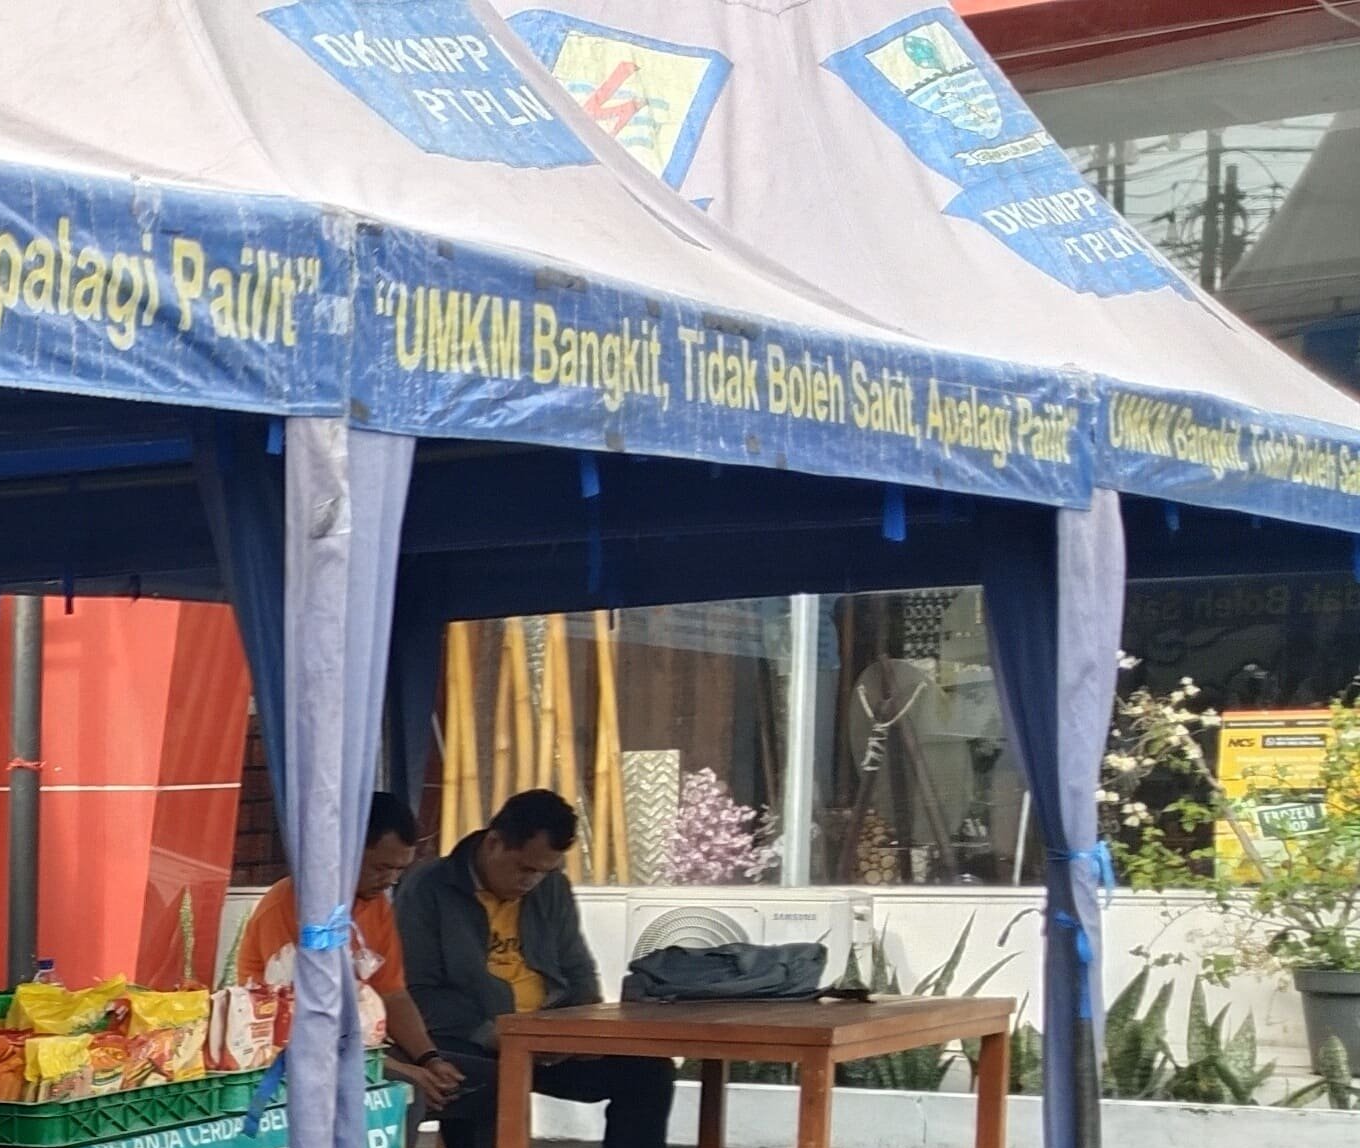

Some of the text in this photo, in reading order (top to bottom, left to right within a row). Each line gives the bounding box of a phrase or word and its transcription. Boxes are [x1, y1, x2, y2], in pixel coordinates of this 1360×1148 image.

[412, 85, 555, 126] PT PLN
[532, 303, 670, 412] Bangkit,
[677, 325, 761, 412] Tidak
[766, 343, 846, 424] Boleh
[851, 360, 922, 449] Sakit,
[926, 378, 1013, 469] Apalagi
[185, 1114, 244, 1147] CERDA
